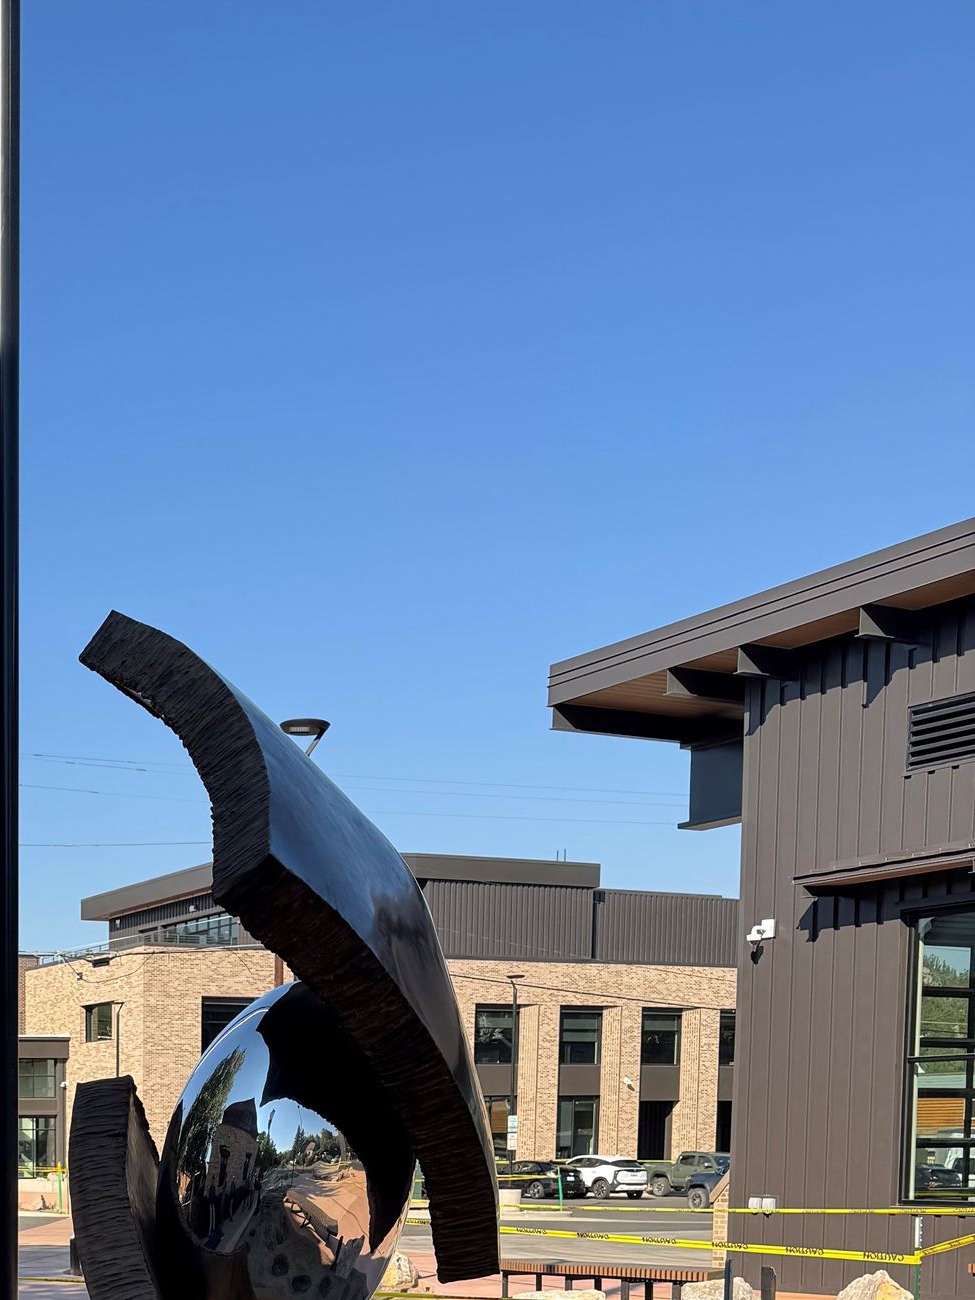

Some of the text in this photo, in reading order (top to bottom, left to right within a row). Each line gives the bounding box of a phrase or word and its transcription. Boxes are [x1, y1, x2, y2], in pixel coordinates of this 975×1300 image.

[577, 1231, 610, 1240] CAUTION
[641, 1236, 677, 1245] CAUTION
[711, 1241, 749, 1250] CAUTION
[785, 1246, 825, 1256] CAUTION
[863, 1251, 905, 1262] CAUTION
